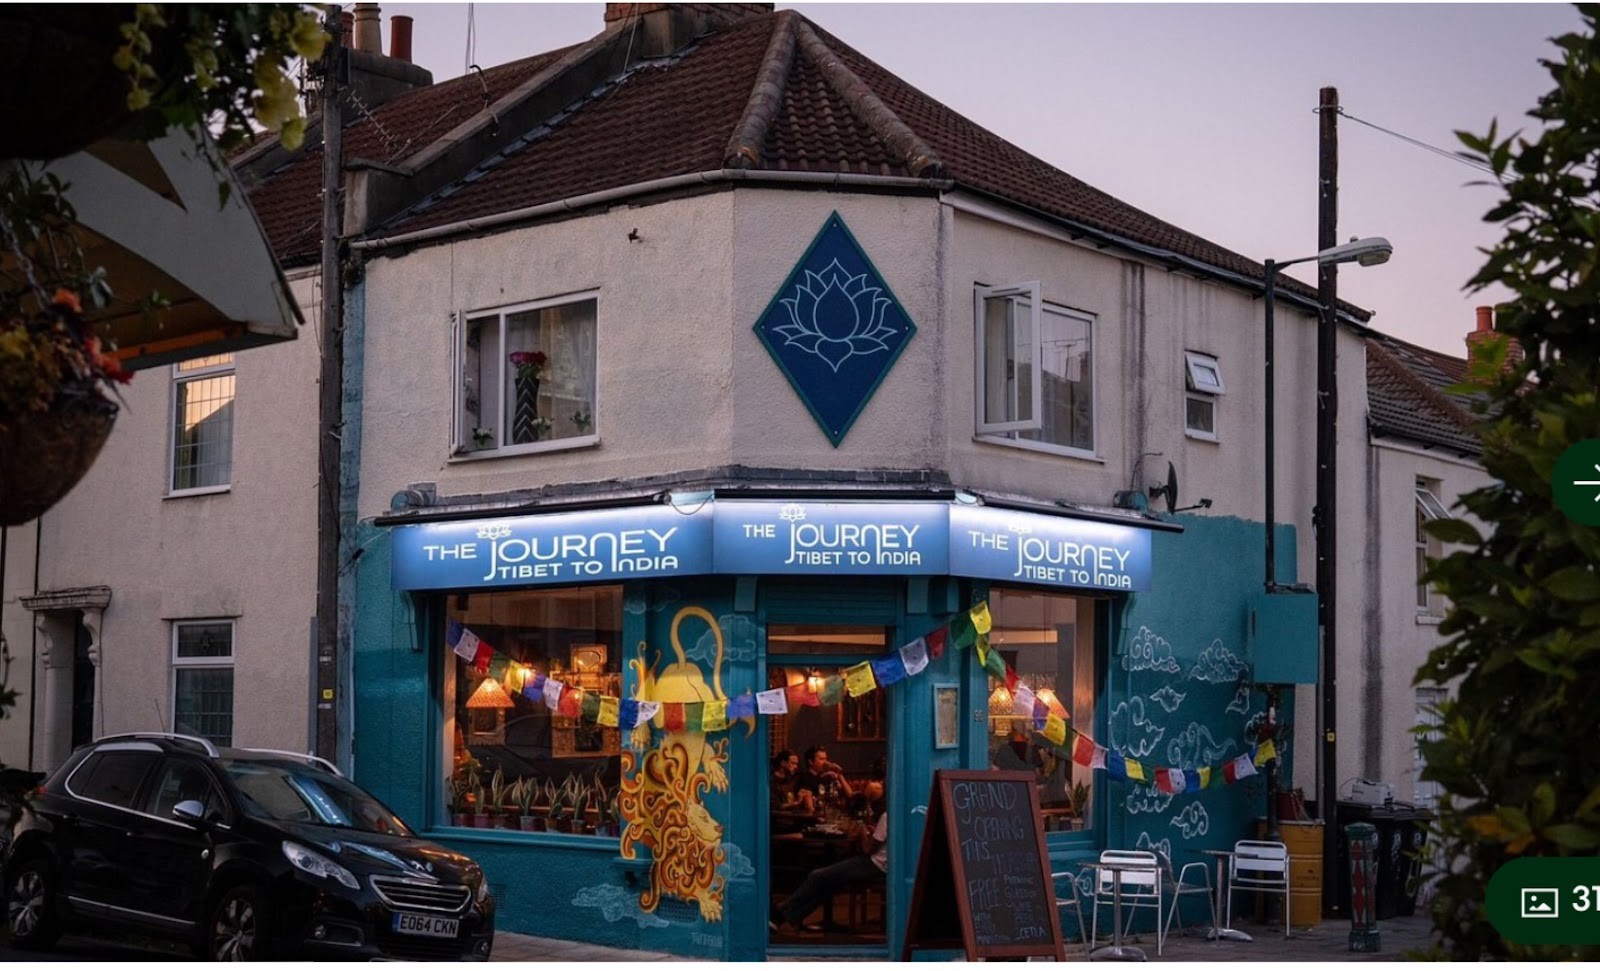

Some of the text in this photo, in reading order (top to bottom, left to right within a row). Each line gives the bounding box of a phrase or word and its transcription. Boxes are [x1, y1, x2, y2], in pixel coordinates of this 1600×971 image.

[423, 527, 678, 581] THE JOURNEY
[743, 523, 920, 564] THE JOURNEY
[796, 551, 841, 565] TIBET
[847, 551, 871, 565] TO
[968, 530, 1131, 577] THE JOURNEY
[498, 562, 563, 579] TIBET
[571, 560, 603, 575] TO
[1023, 565, 1066, 582] TIBET
[1069, 569, 1089, 585] TO
[953, 782, 1016, 824] GRAND
[434, 920, 458, 935] CKN
